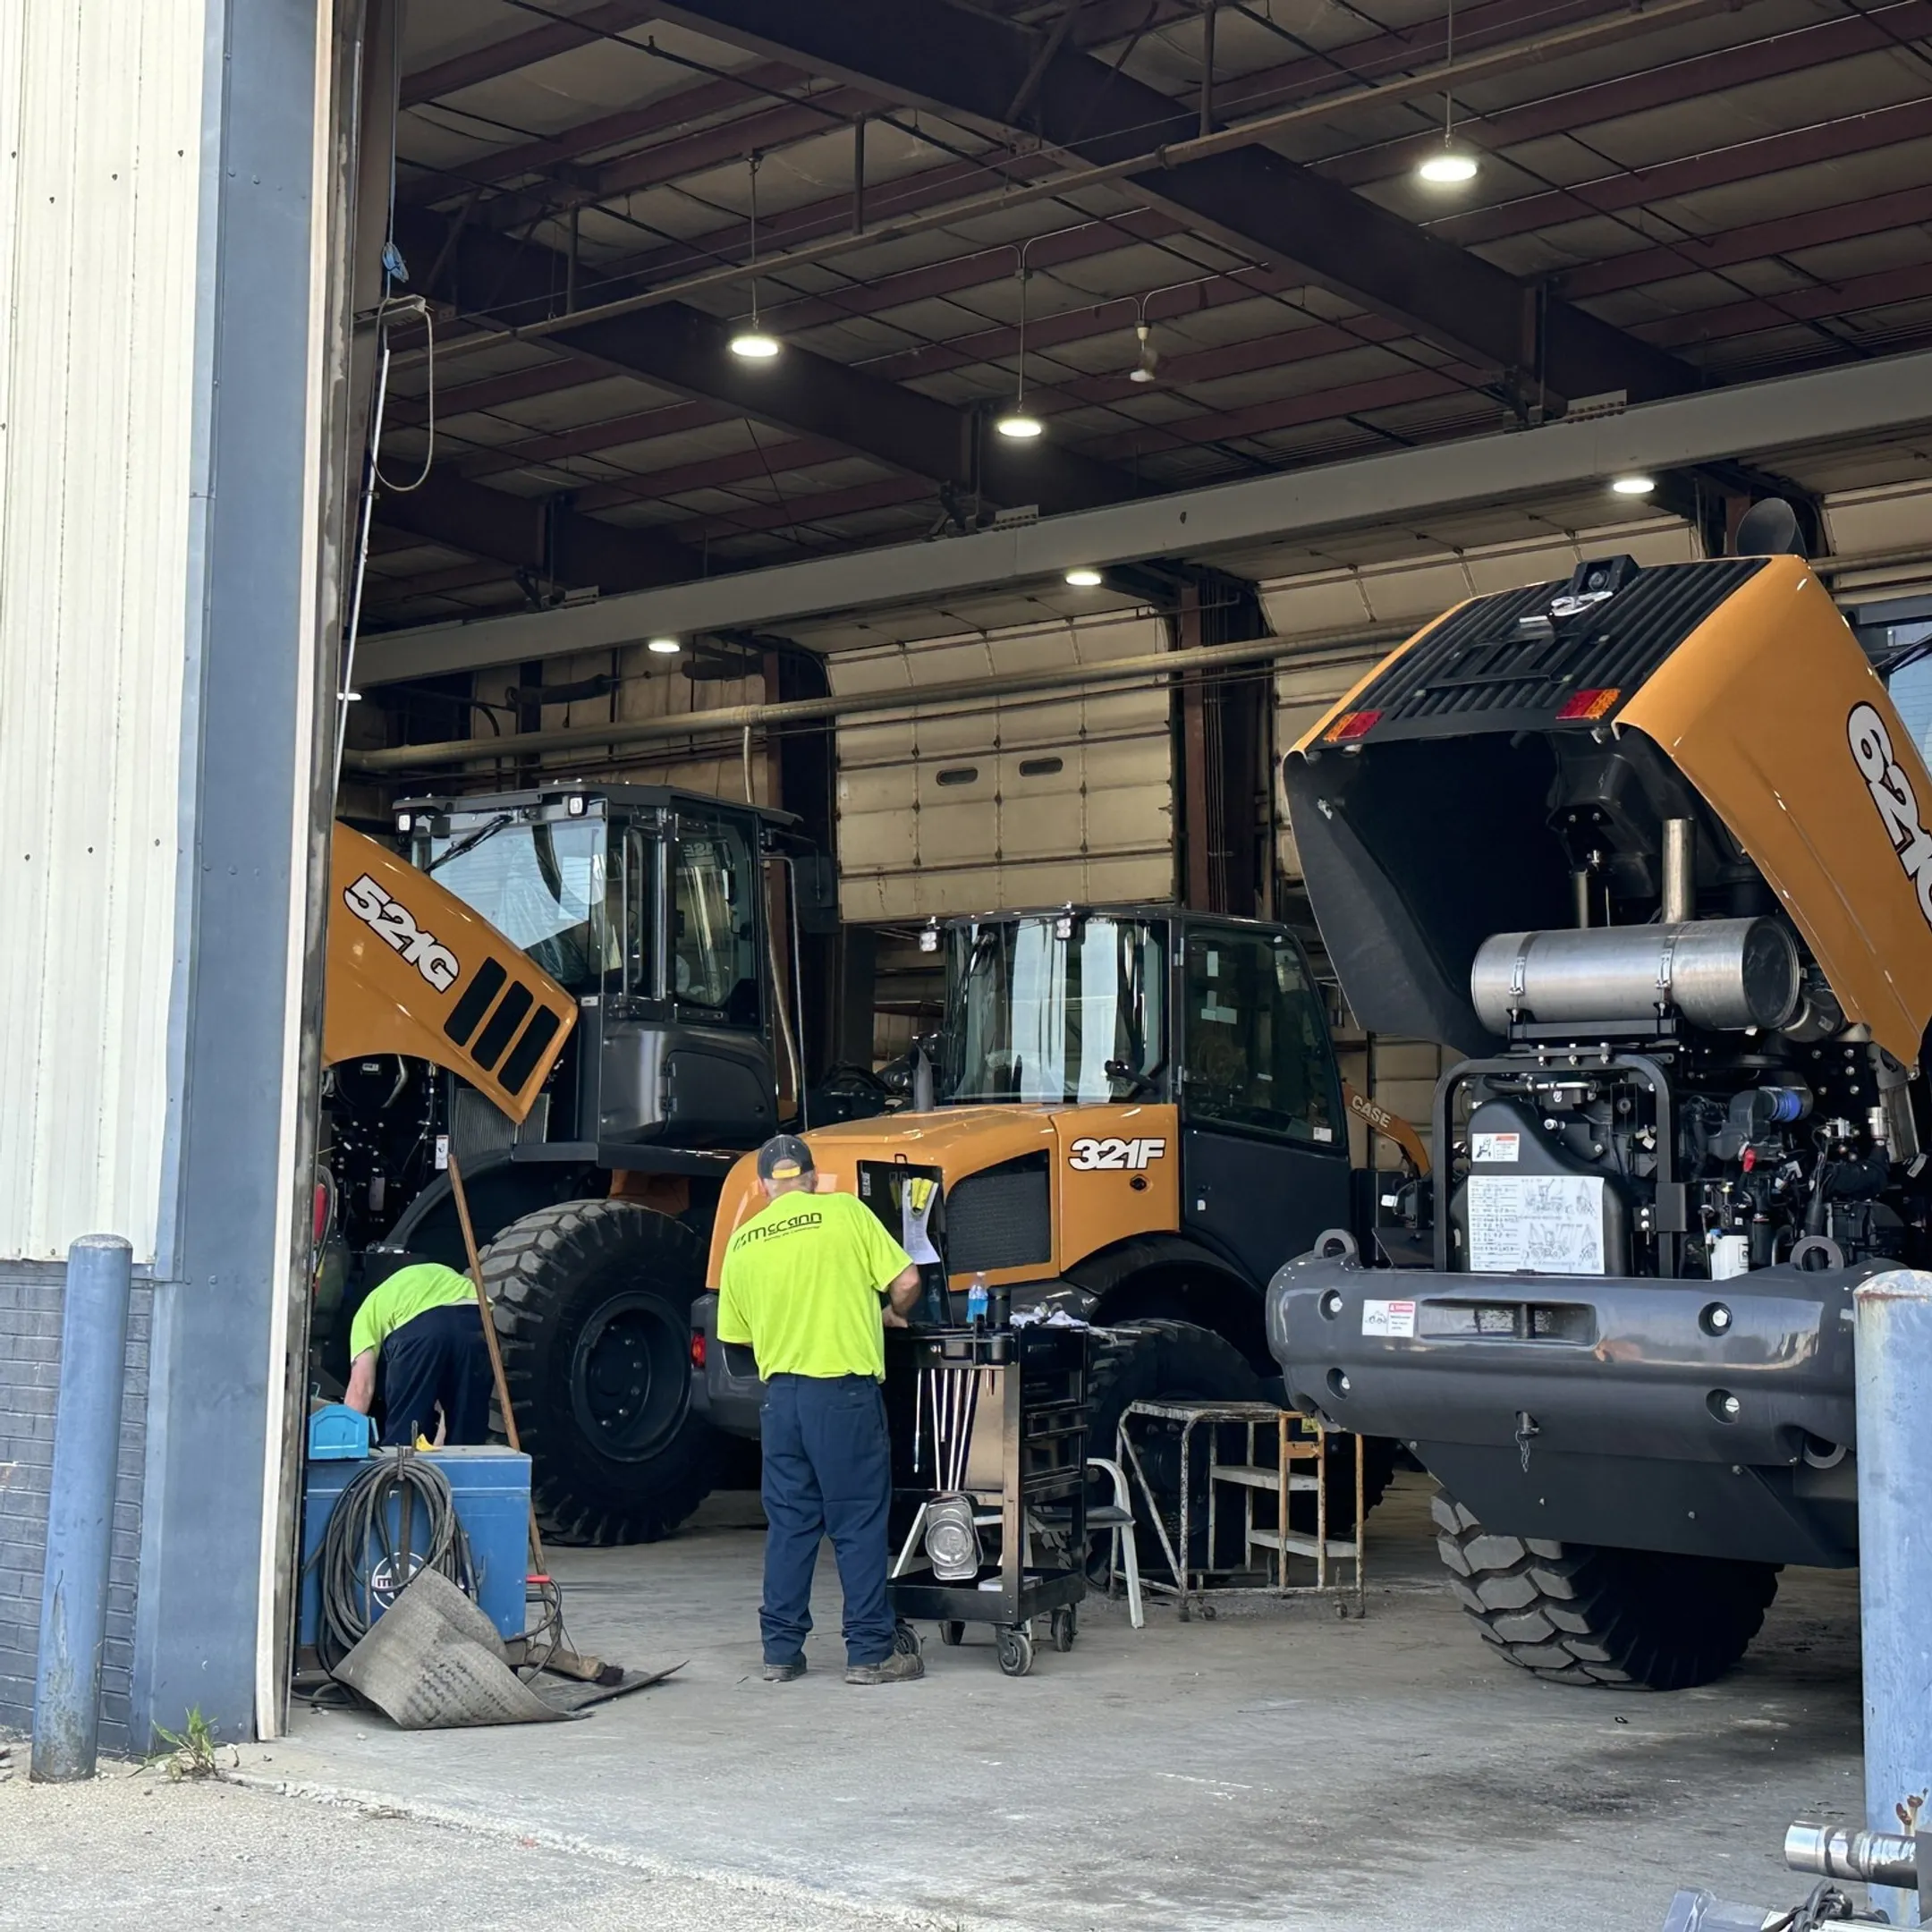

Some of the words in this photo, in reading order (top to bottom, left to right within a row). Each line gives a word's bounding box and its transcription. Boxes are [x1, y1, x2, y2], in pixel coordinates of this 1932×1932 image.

[343, 872, 460, 995] 521G
[1352, 1095, 1392, 1128] CASE
[1068, 1137, 1166, 1171] 321F
